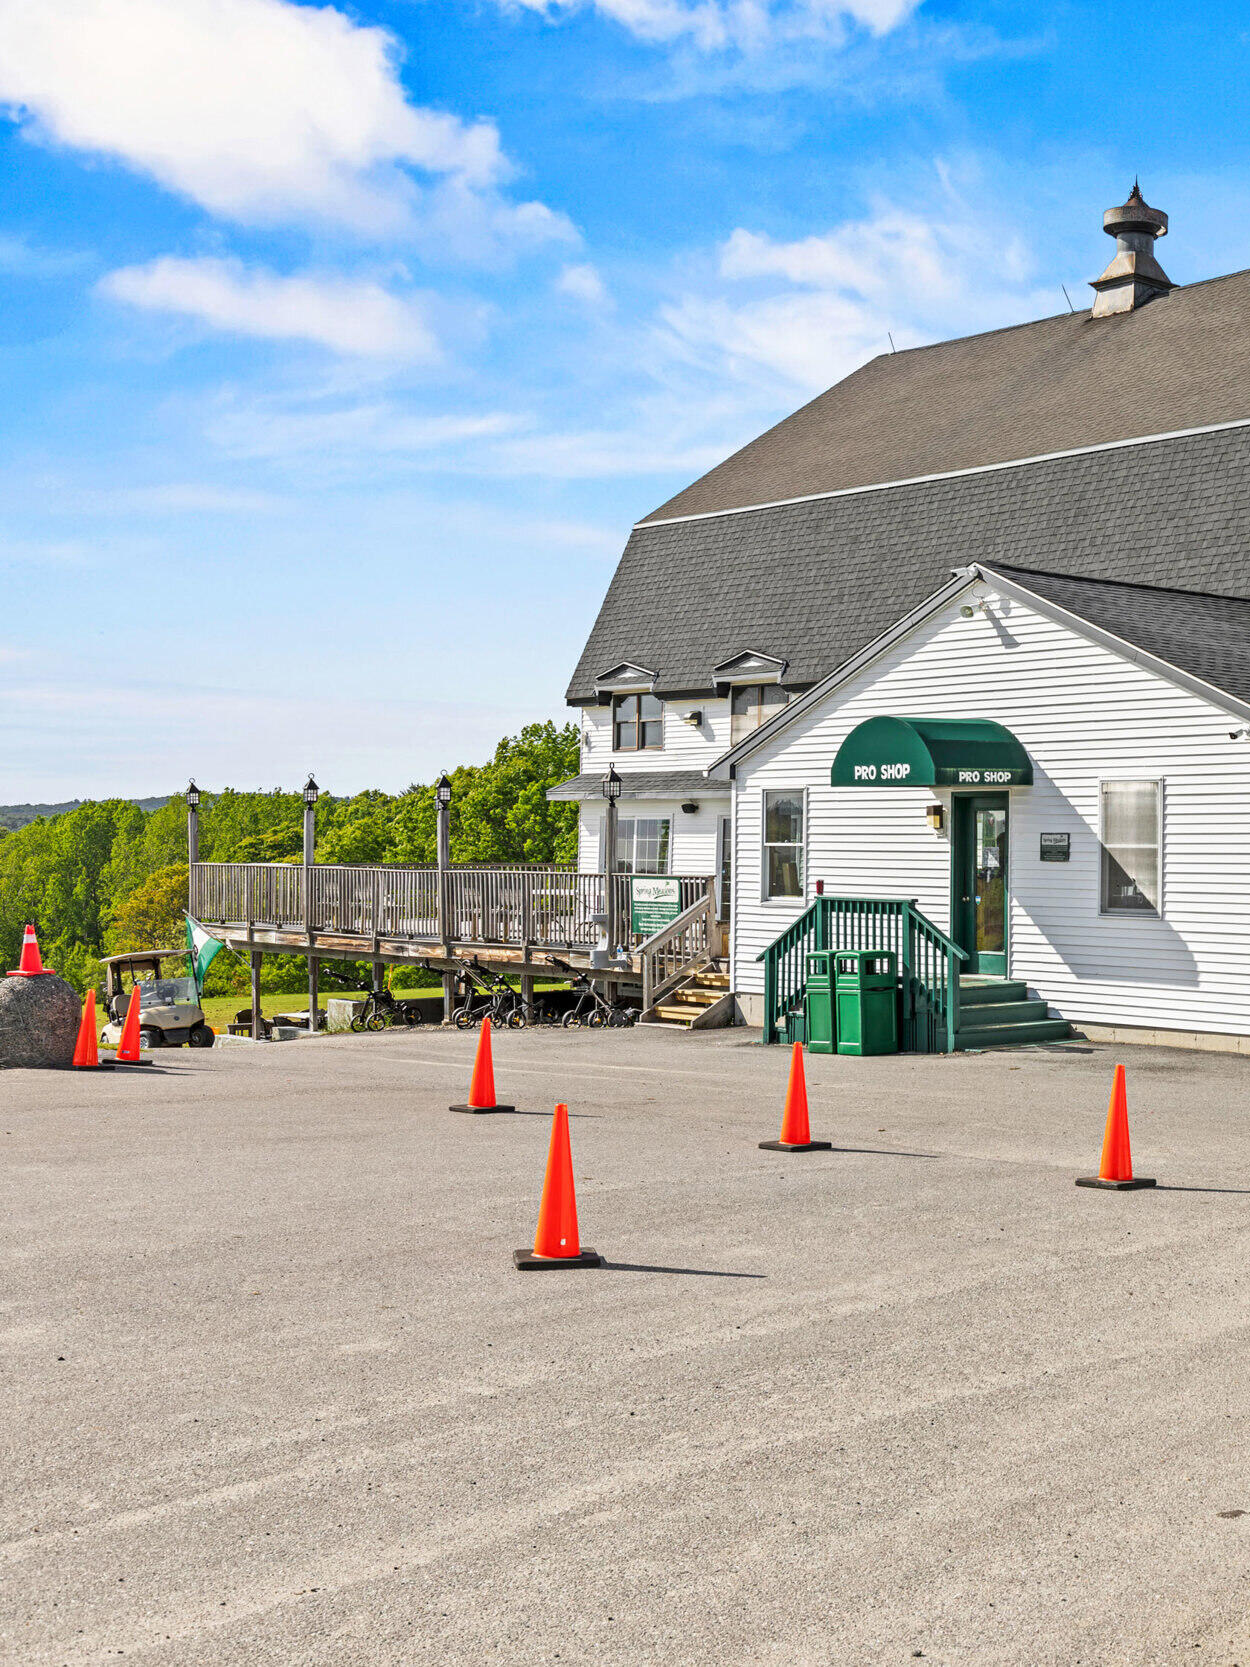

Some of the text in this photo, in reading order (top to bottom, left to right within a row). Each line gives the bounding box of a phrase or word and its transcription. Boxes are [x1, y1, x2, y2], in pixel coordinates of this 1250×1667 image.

[854, 764, 911, 780] PRO SHOP
[958, 771, 1012, 783] PRO SHOP
